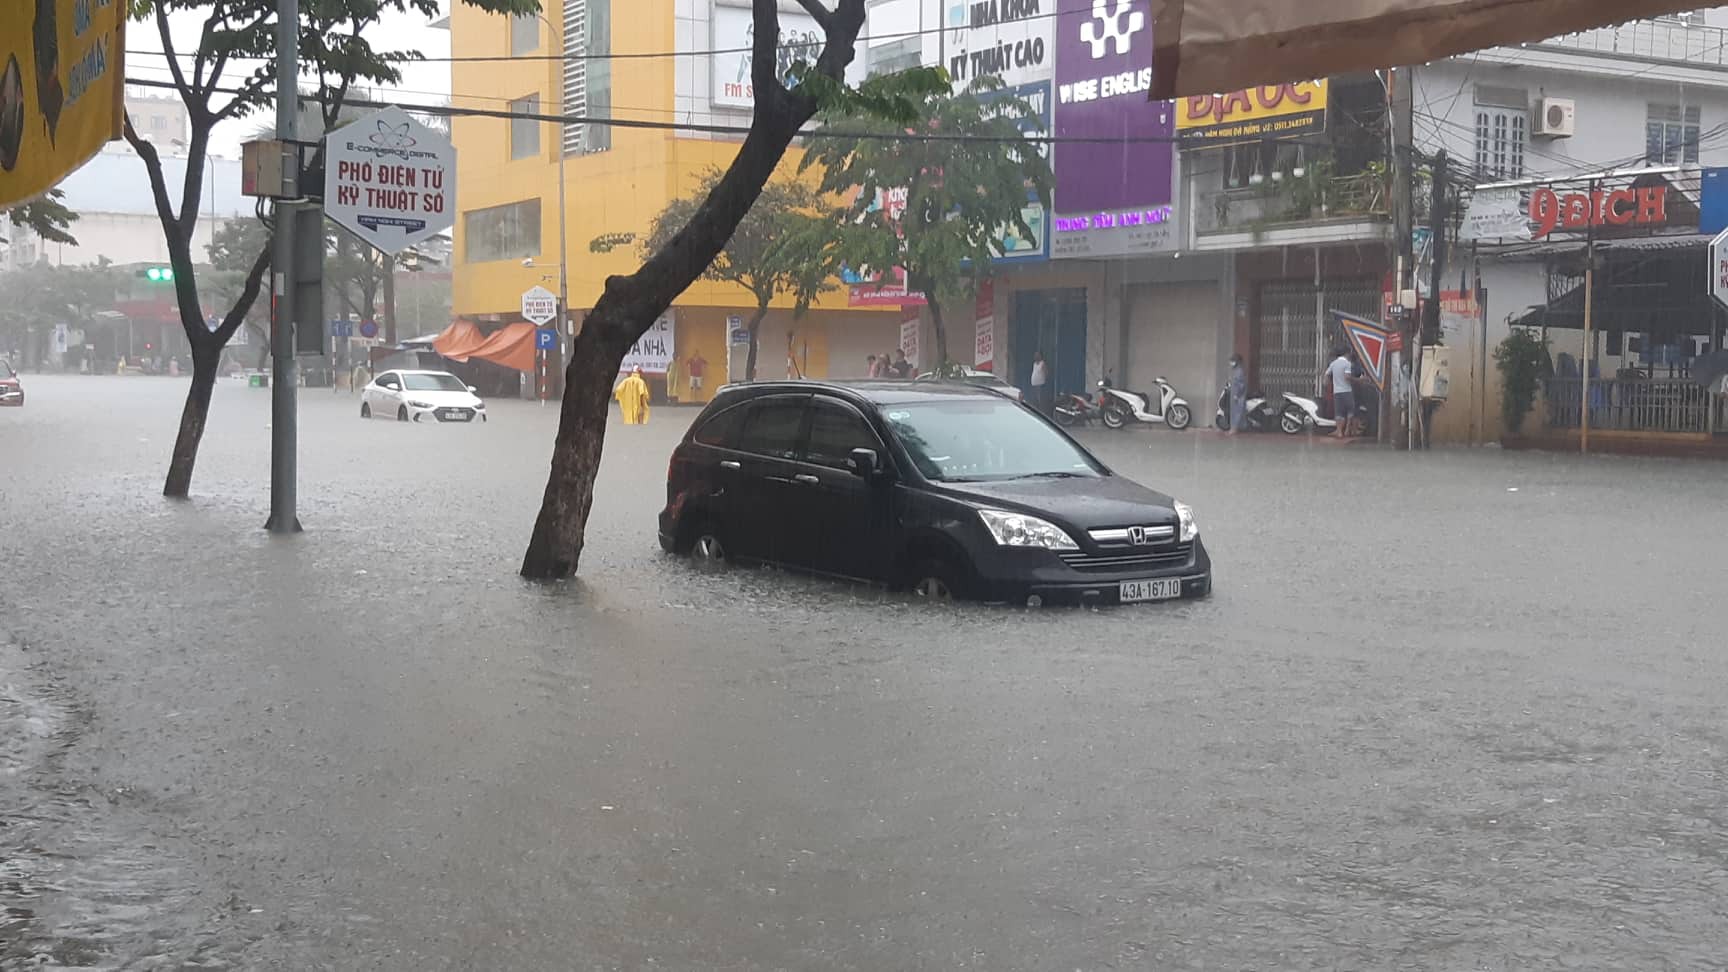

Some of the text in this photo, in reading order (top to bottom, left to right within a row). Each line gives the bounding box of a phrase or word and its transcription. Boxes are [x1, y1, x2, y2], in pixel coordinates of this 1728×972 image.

[1015, 37, 1044, 68] CAO
[725, 83, 742, 97] FM
[1059, 67, 1152, 104] WISE ENGLIS
[377, 164, 416, 188] ĐIỆN
[365, 187, 418, 213] THUẬT
[423, 189, 445, 214] SỐ
[1529, 189, 1559, 240] 9
[541, 333, 551, 346] P
[1122, 580, 1179, 599] 43A-167.10
